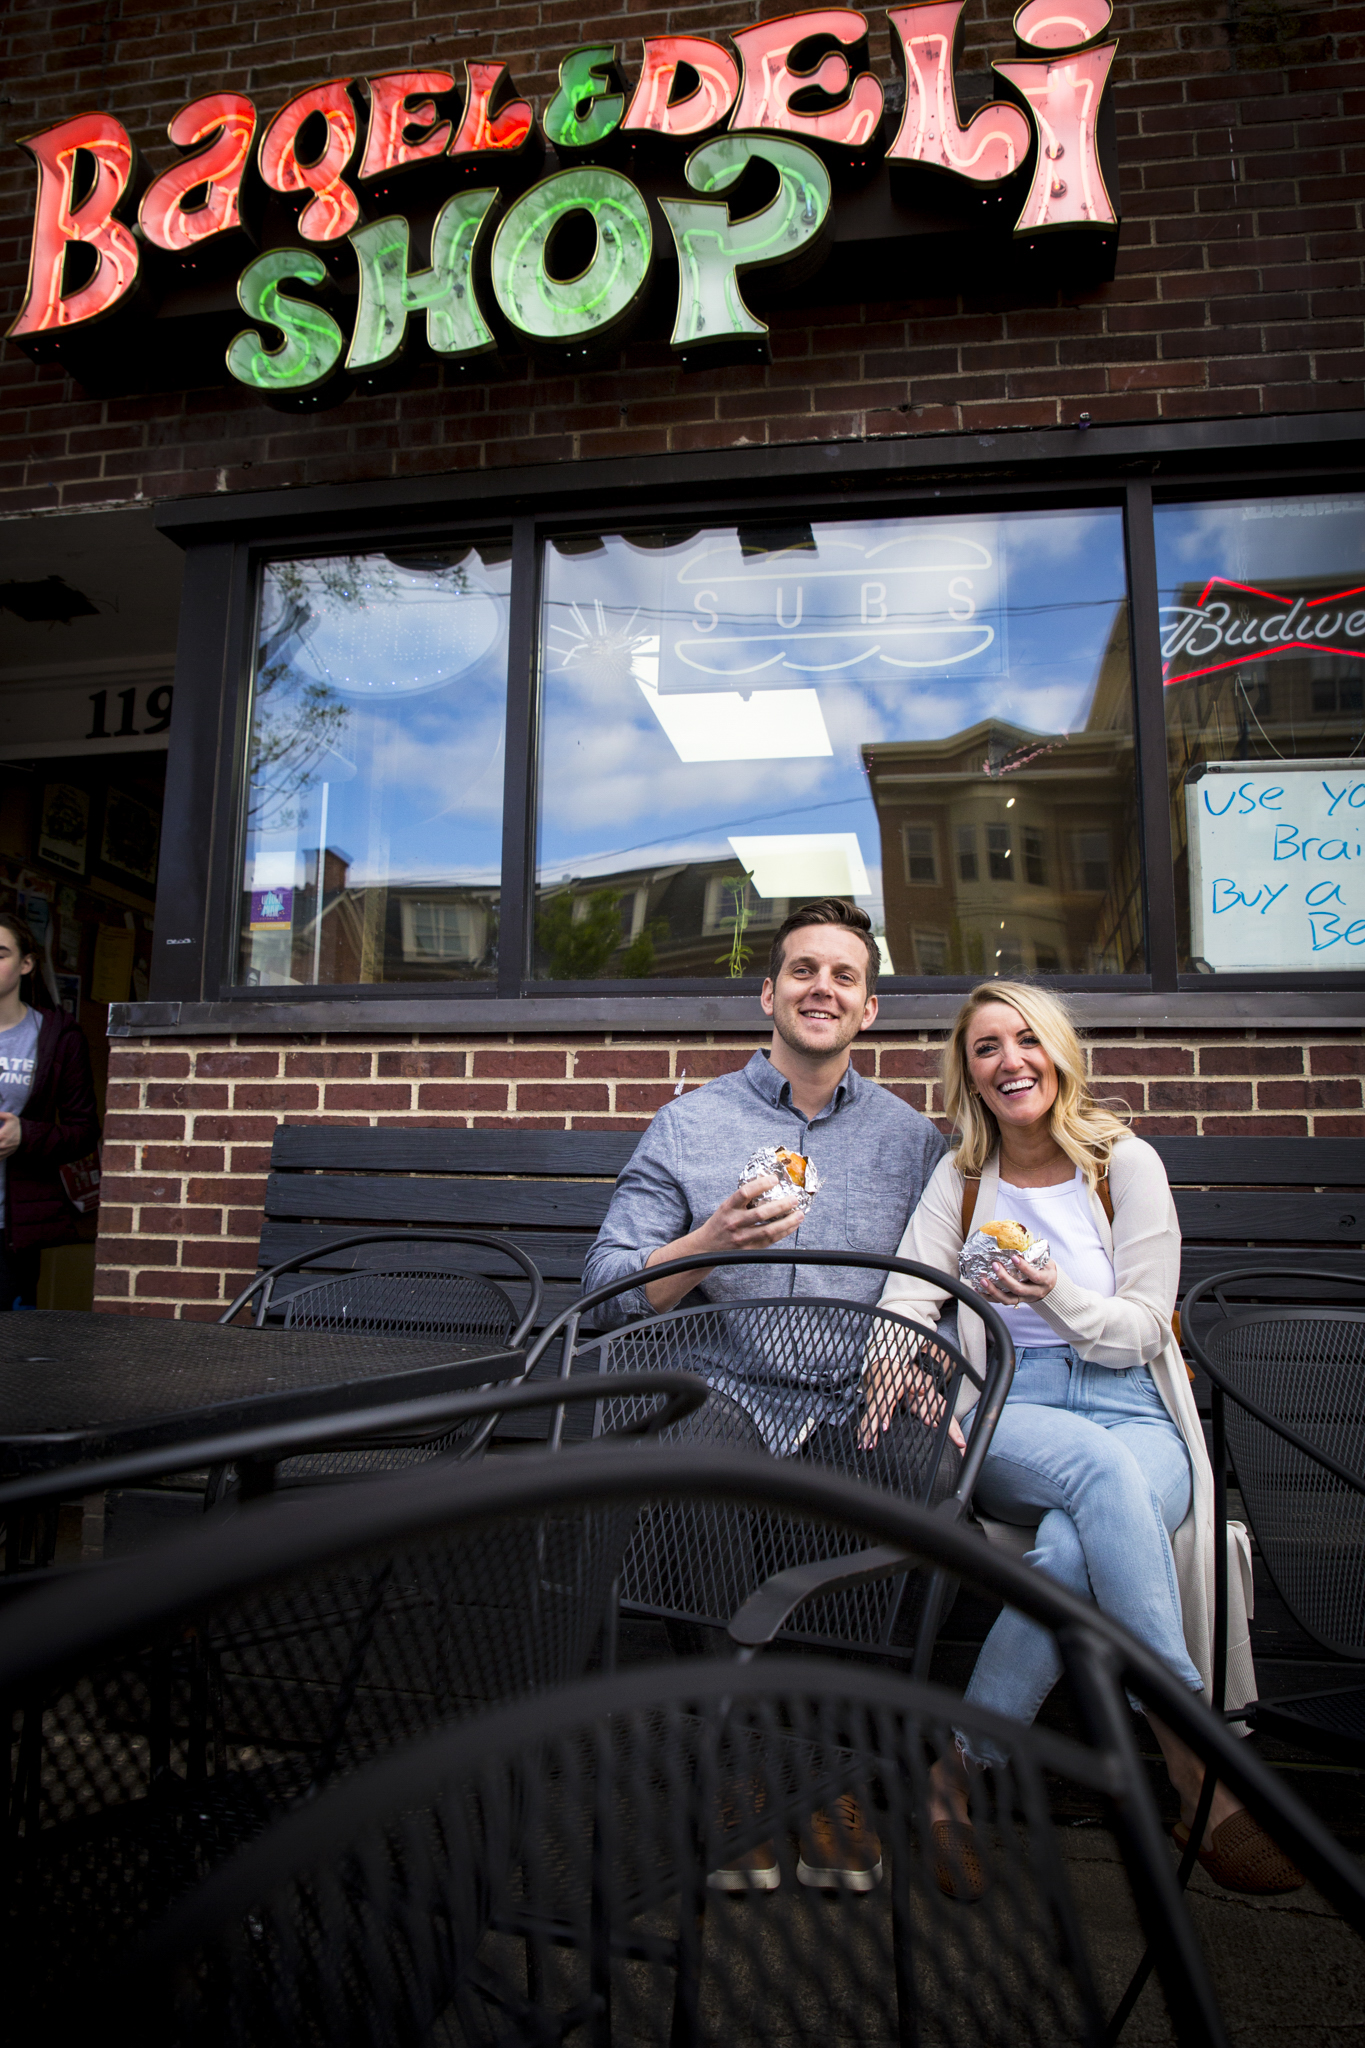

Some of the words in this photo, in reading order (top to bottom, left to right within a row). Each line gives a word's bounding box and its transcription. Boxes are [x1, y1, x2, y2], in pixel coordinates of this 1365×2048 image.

[542, 45, 625, 147] &
[225, 133, 832, 391] SHOP
[692, 576, 977, 633] SUBS
[85, 684, 174, 739] 119
[1273, 823, 1361, 861] Brai
[1305, 880, 1347, 907] a
[1307, 911, 1365, 951] Be
